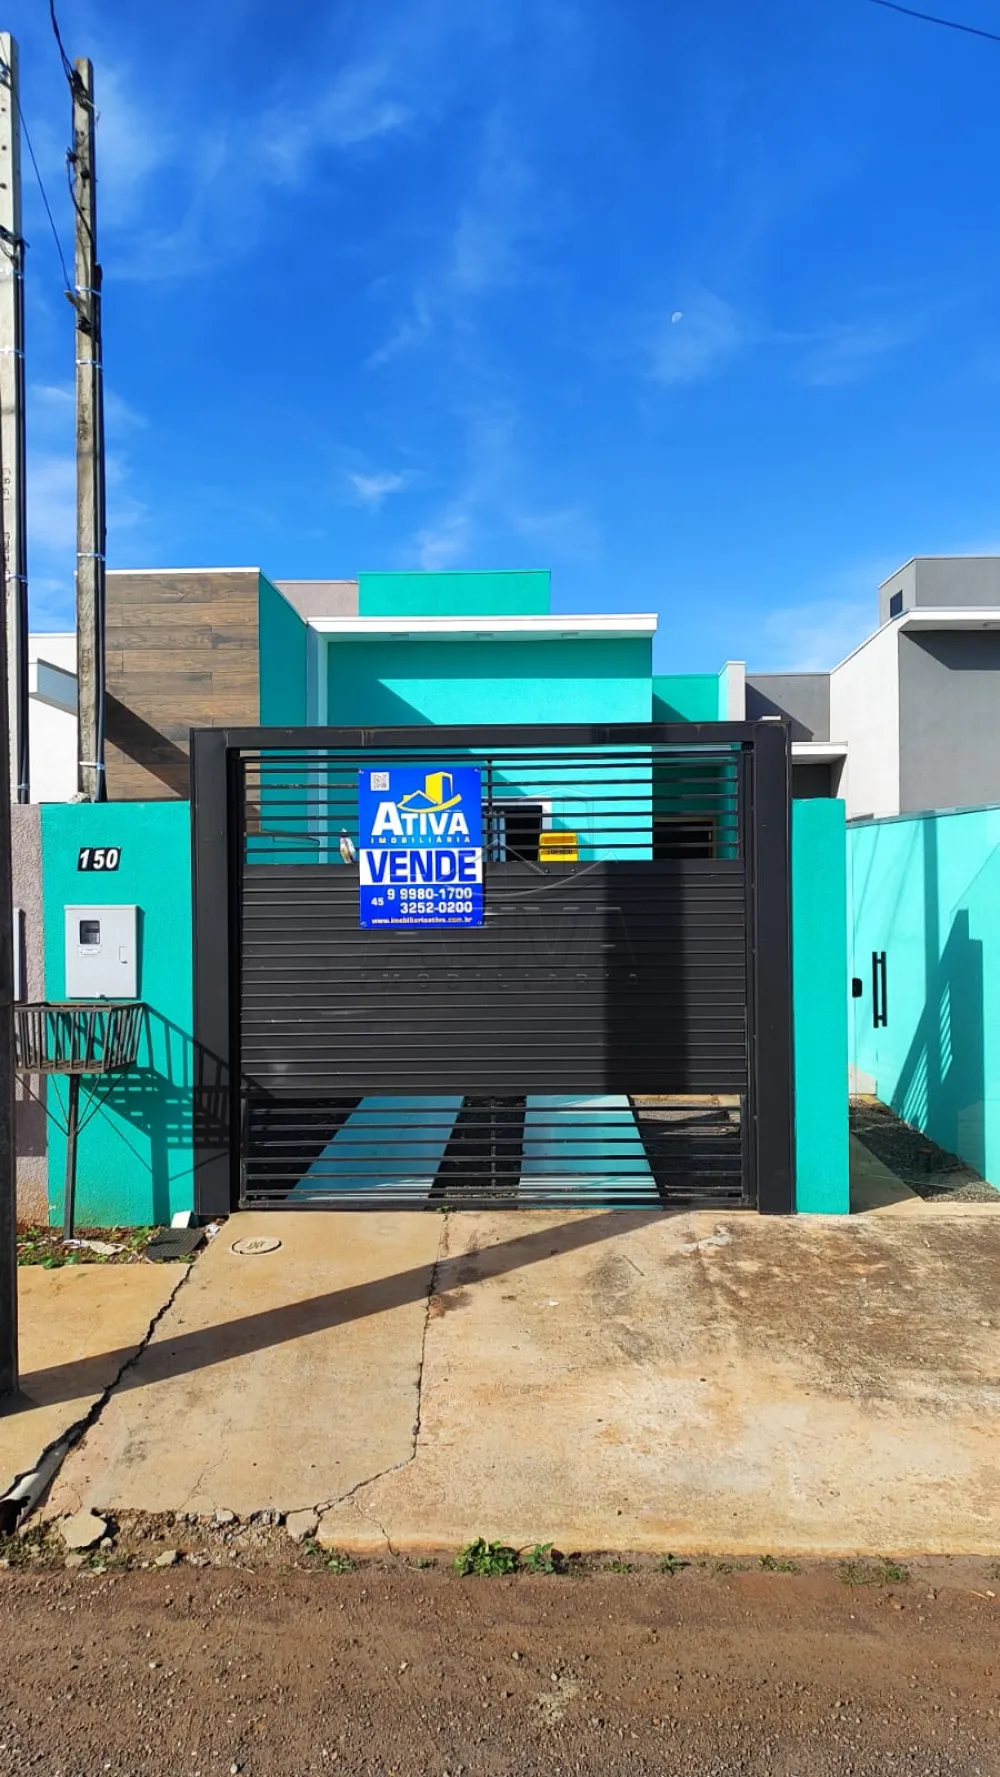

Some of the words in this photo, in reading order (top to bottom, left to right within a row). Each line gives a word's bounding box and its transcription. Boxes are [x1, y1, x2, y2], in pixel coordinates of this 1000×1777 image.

[371, 801, 469, 836] ATIVA
[80, 850, 118, 869] 150
[366, 850, 476, 883] VENDE
[371, 897, 384, 906] 45
[387, 889, 395, 900] 9
[400, 888, 472, 900] 9980-1700
[400, 902, 472, 914] 3252-0200
